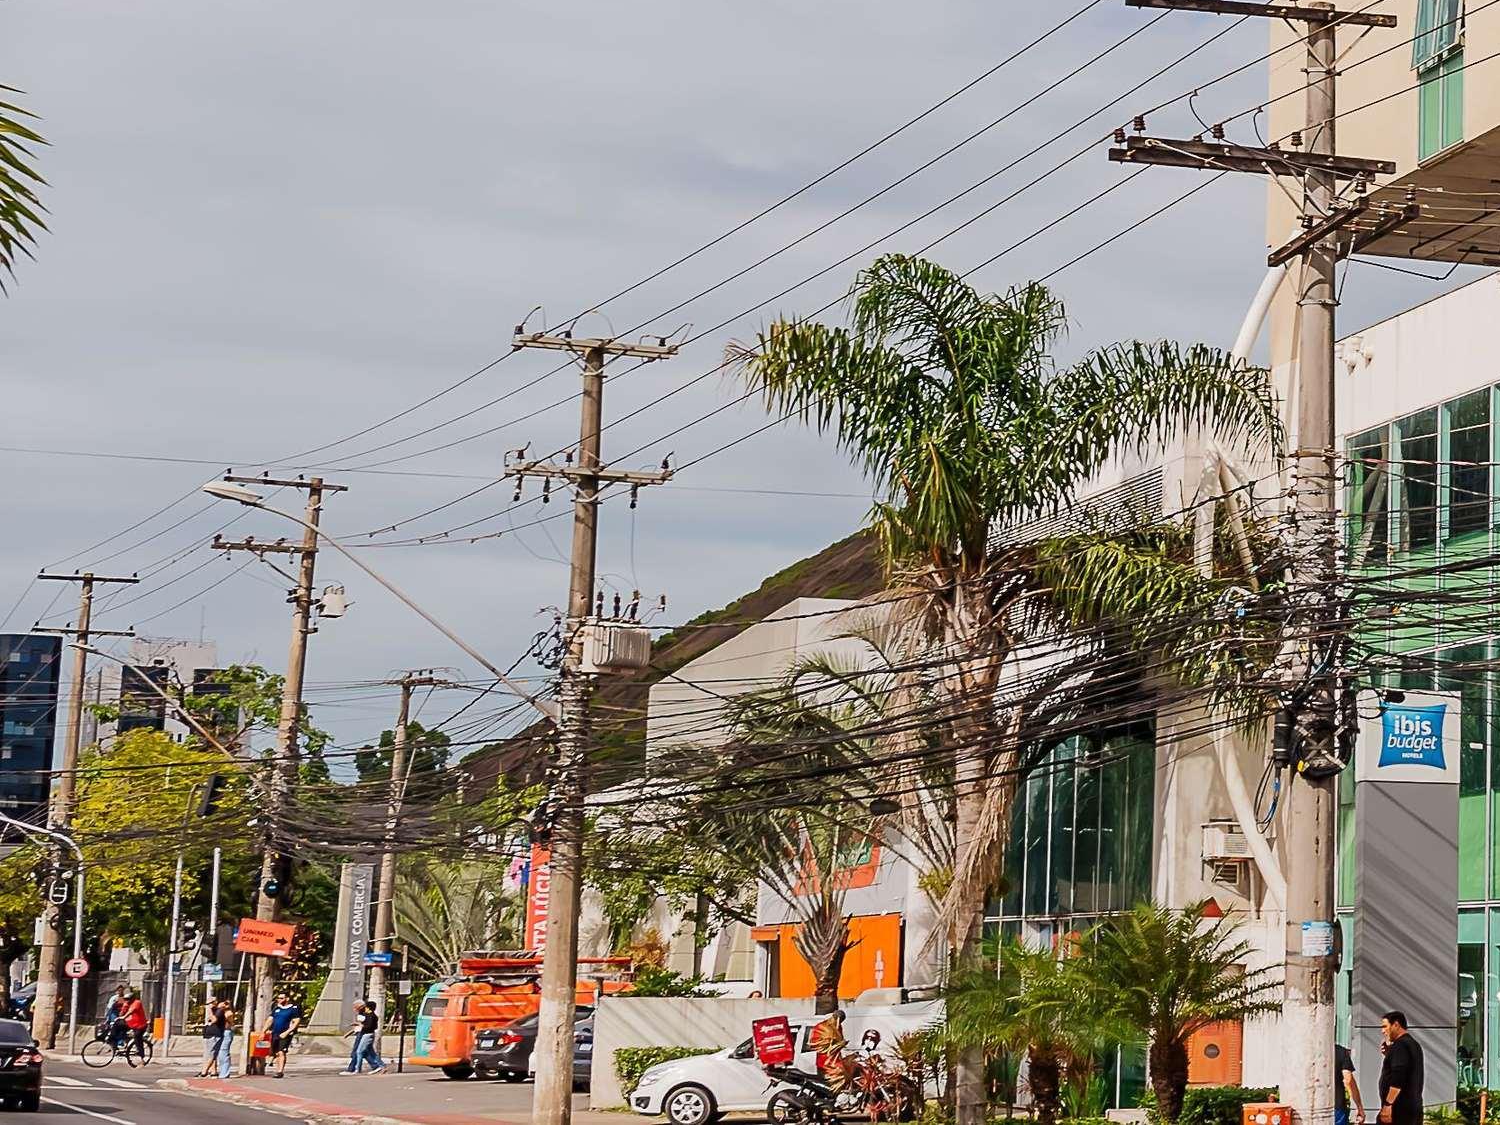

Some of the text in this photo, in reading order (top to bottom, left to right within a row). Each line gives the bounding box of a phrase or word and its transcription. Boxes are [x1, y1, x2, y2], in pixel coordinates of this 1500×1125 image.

[1394, 714, 1432, 736] ibis
[1387, 734, 1438, 752] budget
[349, 939, 361, 974] JUNTA
